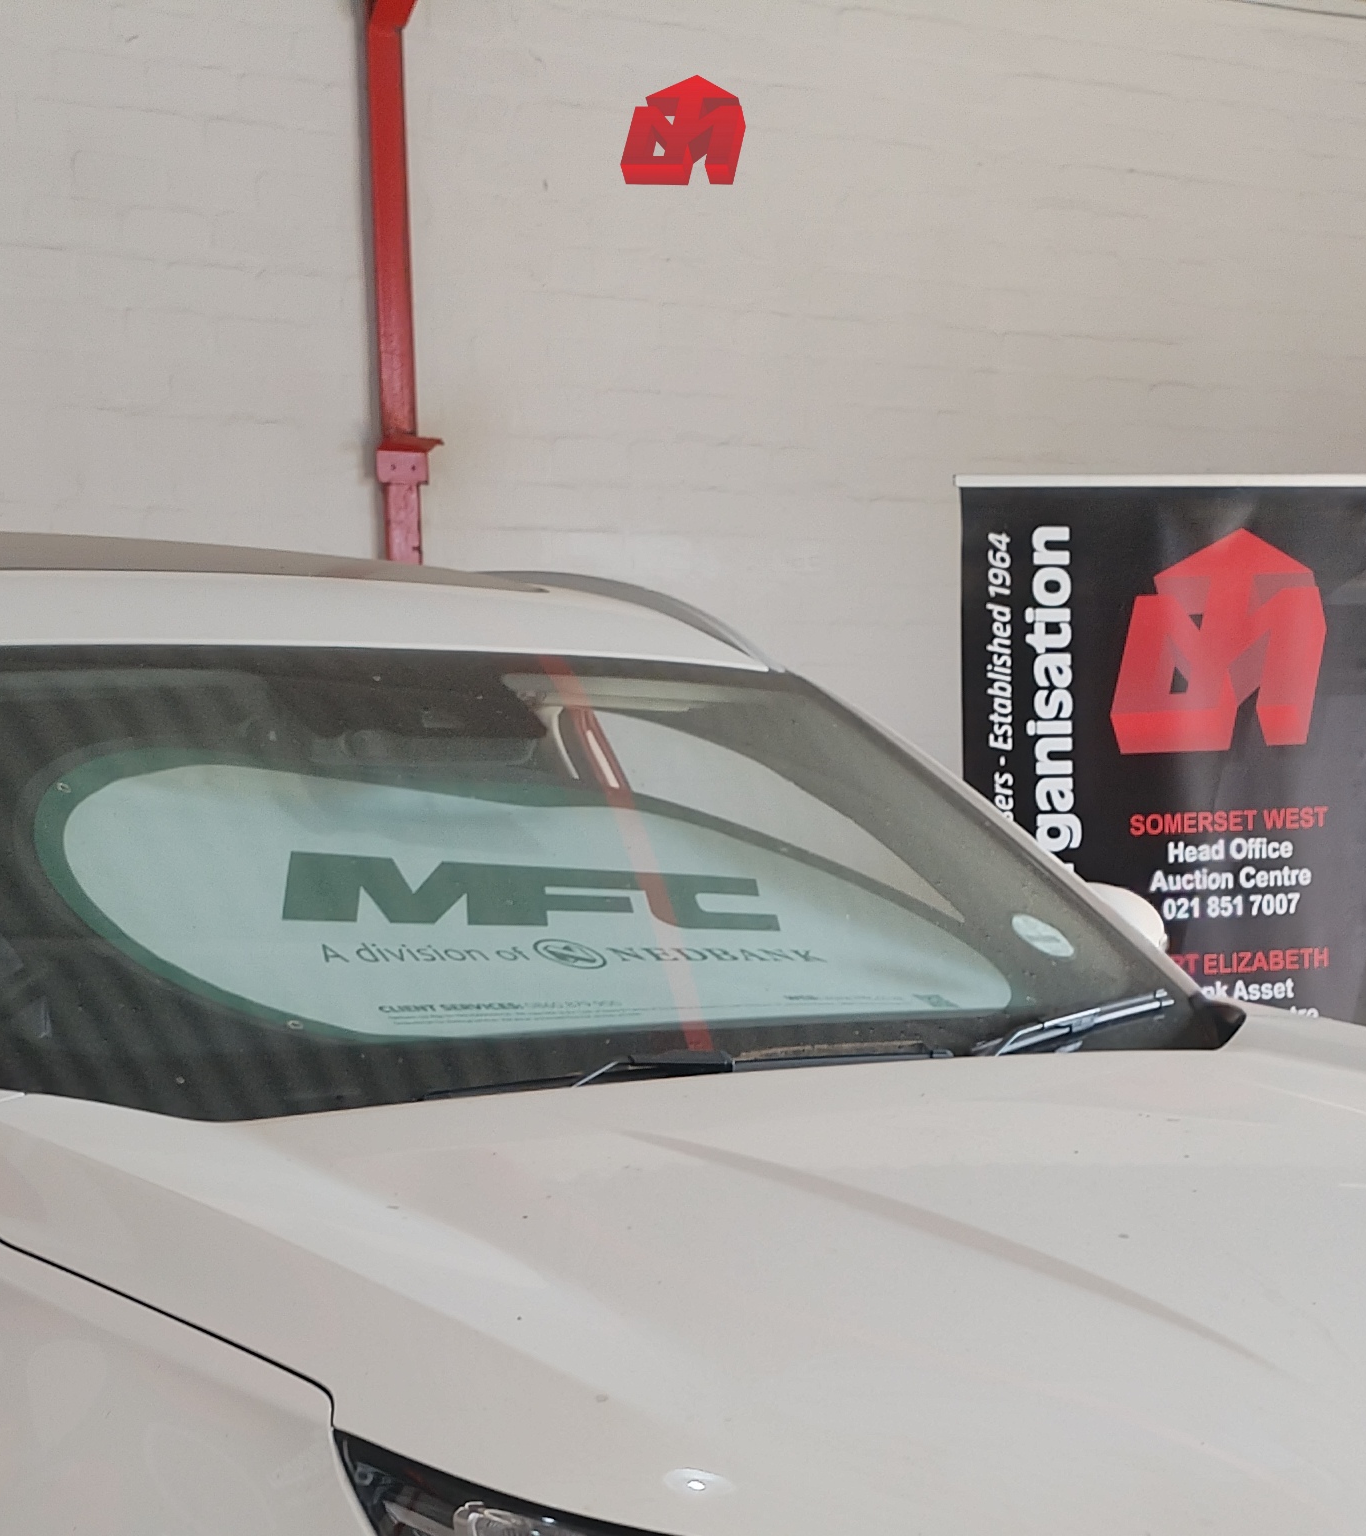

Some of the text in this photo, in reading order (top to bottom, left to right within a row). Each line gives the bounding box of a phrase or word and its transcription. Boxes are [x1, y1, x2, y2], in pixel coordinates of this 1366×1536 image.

[988, 532, 1012, 597] 1964
[986, 603, 1013, 750] Established
[1025, 526, 1082, 872] ganisation
[1129, 807, 1328, 836] SOMERSET WEST
[1168, 838, 1293, 863] Head Office
[282, 851, 780, 931] MFC
[1150, 866, 1312, 892] Auction Centre
[1163, 893, 1300, 920] 021 851 7007
[322, 942, 828, 965] A division of NEDBANK
[1203, 948, 1329, 974] ELIZABETH
[1234, 979, 1294, 1001] Asset
